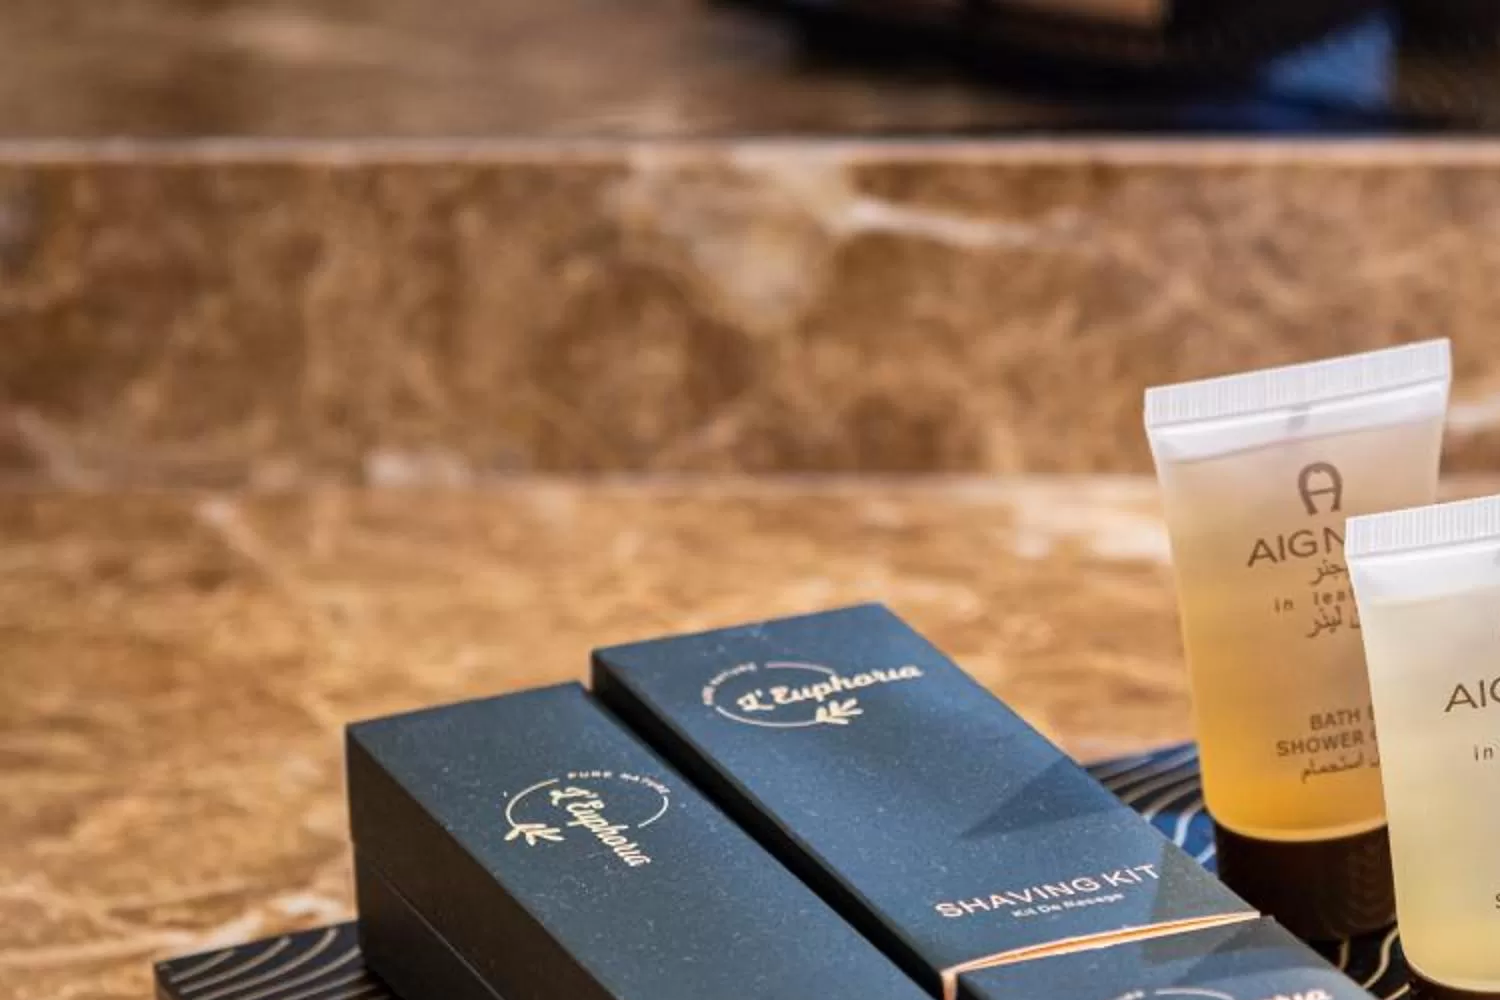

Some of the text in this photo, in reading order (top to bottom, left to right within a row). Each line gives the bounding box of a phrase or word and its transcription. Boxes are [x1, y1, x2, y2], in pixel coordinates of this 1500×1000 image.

[1247, 527, 1344, 568] AIGN
[1310, 708, 1361, 731] BATH
[1275, 729, 1364, 757] SHOWER
[1473, 744, 1494, 762] in
[935, 863, 1160, 918] SHAVING KIT
